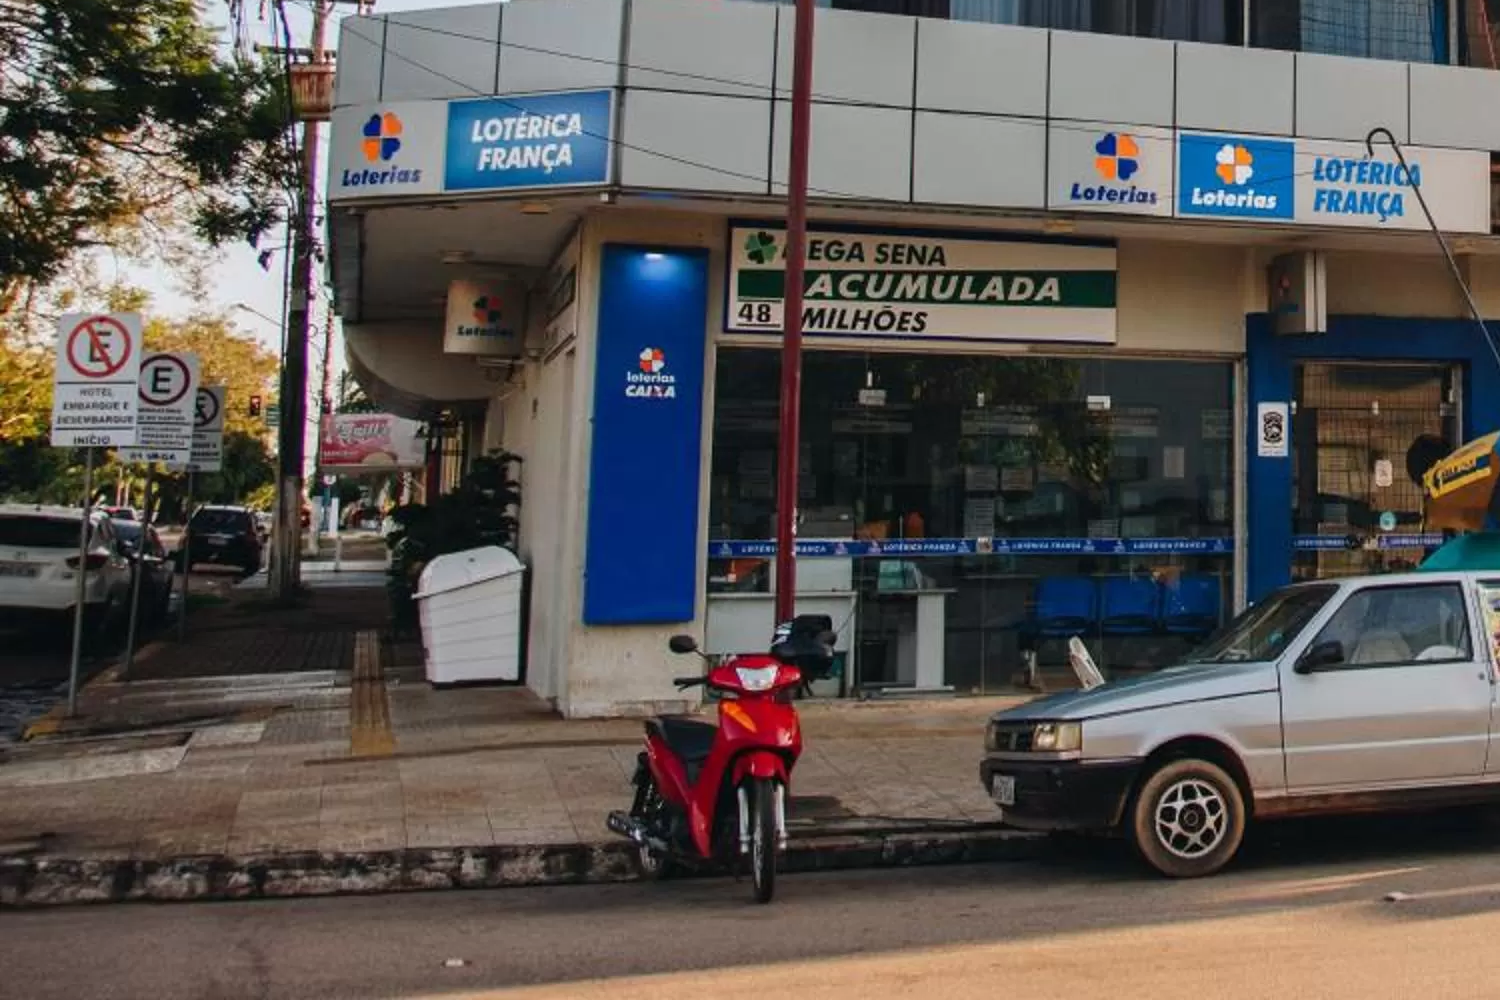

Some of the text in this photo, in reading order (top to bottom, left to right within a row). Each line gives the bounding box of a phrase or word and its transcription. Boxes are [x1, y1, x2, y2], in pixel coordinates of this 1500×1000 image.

[471, 110, 583, 143] LOTÉRICA
[476, 143, 573, 174] FRANÇA
[1312, 153, 1422, 187] LOTÉRICA
[341, 165, 423, 187] Loterias
[1070, 183, 1158, 206] Loterias
[1191, 188, 1277, 210] Loterias
[1312, 187, 1405, 222] FRANÇA
[874, 240, 947, 267] SENA
[802, 271, 1062, 302] ACUMULADA
[737, 303, 929, 333] 48 MILHÕES
[151, 366, 173, 394] E
[627, 370, 676, 383] loterias
[625, 384, 676, 398] CAIXA
[73, 433, 111, 445] INÍCIO
